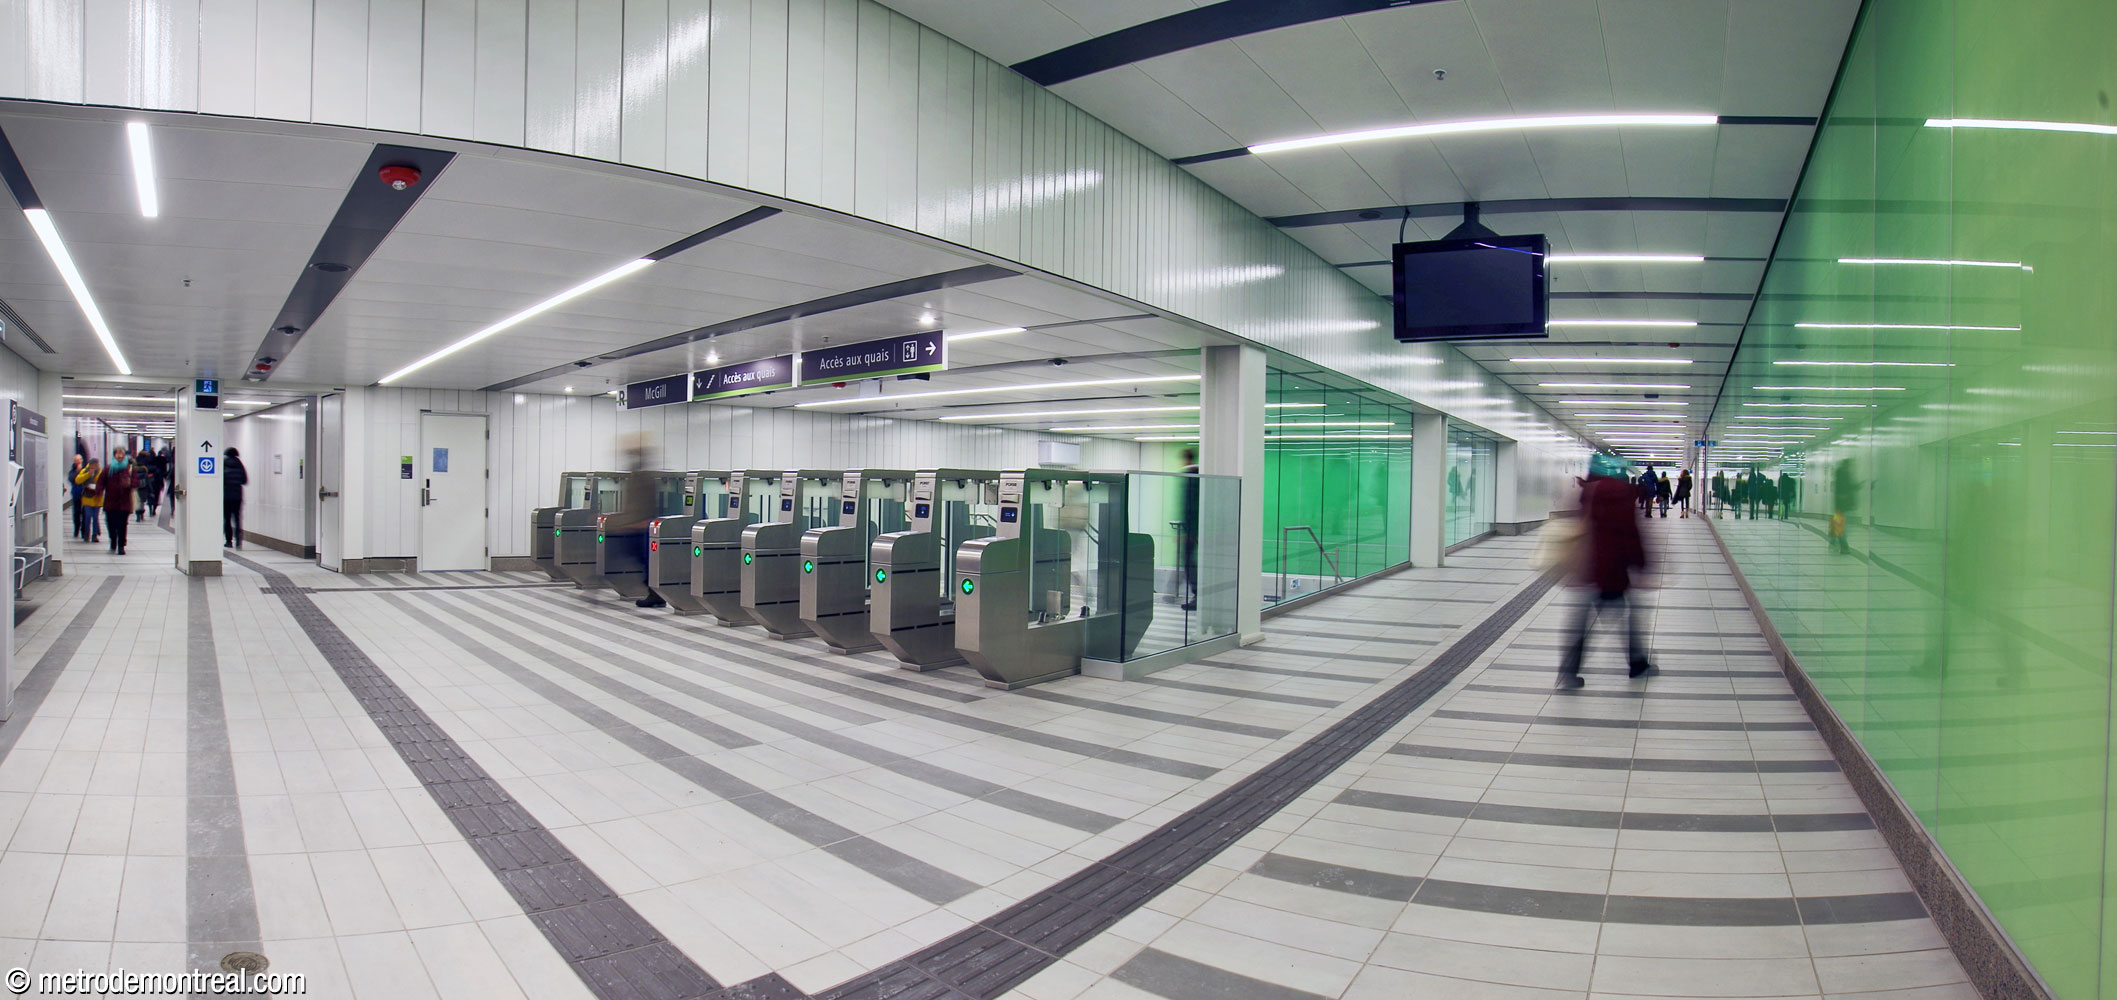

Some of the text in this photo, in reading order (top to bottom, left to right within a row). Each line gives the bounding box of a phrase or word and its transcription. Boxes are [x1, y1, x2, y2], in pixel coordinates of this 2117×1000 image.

[820, 348, 889, 370] Accès aux quais
[723, 367, 776, 385] Accès aux quais
[644, 384, 667, 400] McGill
